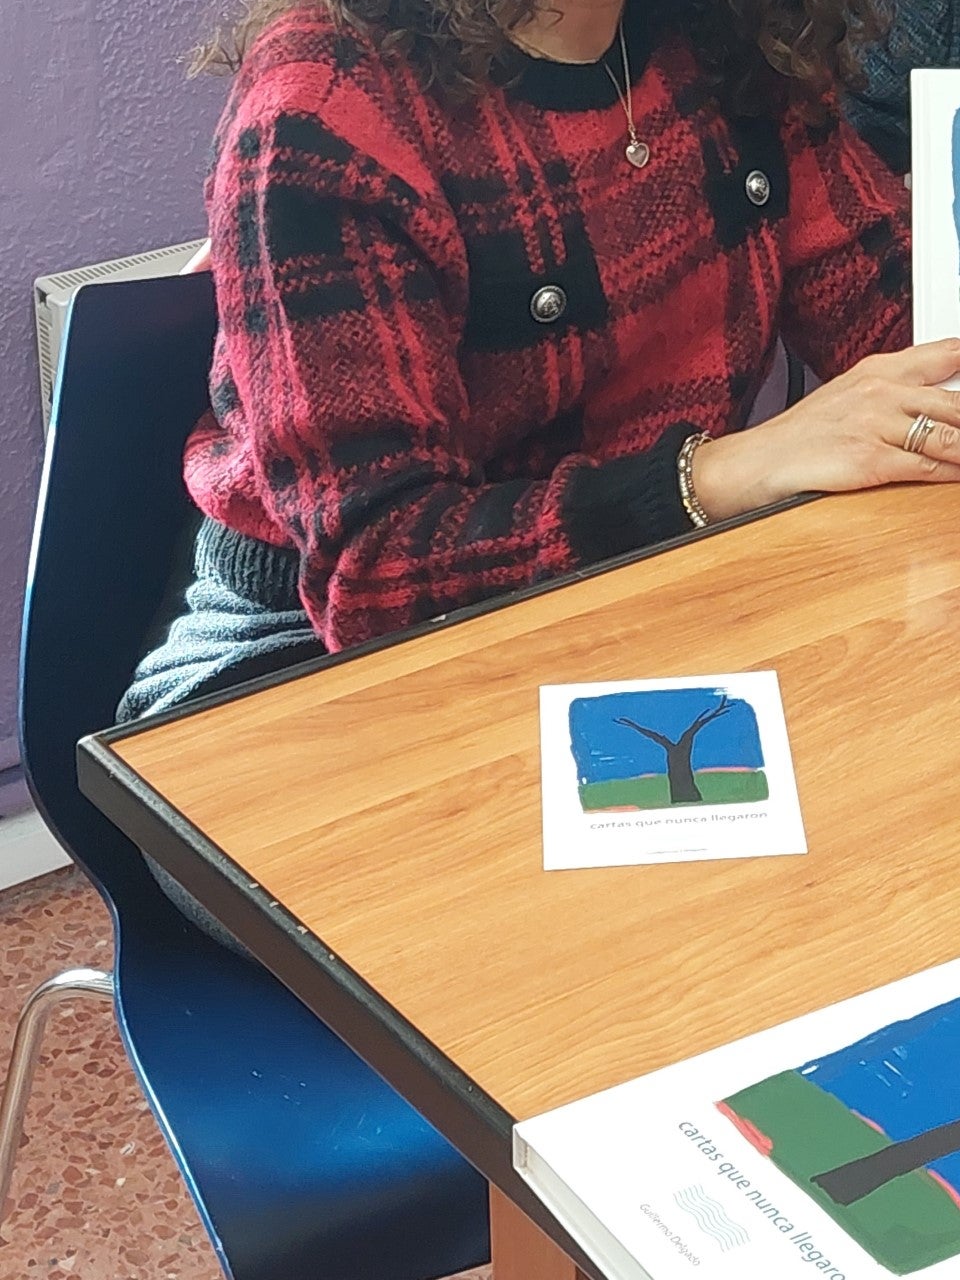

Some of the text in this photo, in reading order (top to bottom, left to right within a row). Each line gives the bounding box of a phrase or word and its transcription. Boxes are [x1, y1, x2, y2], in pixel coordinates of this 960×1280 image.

[590, 812, 768, 830] cartas que nunca llegaron
[678, 1121, 846, 1280] cartas que nunca llegaro
[639, 1203, 701, 1267] Guillermo Delgado
